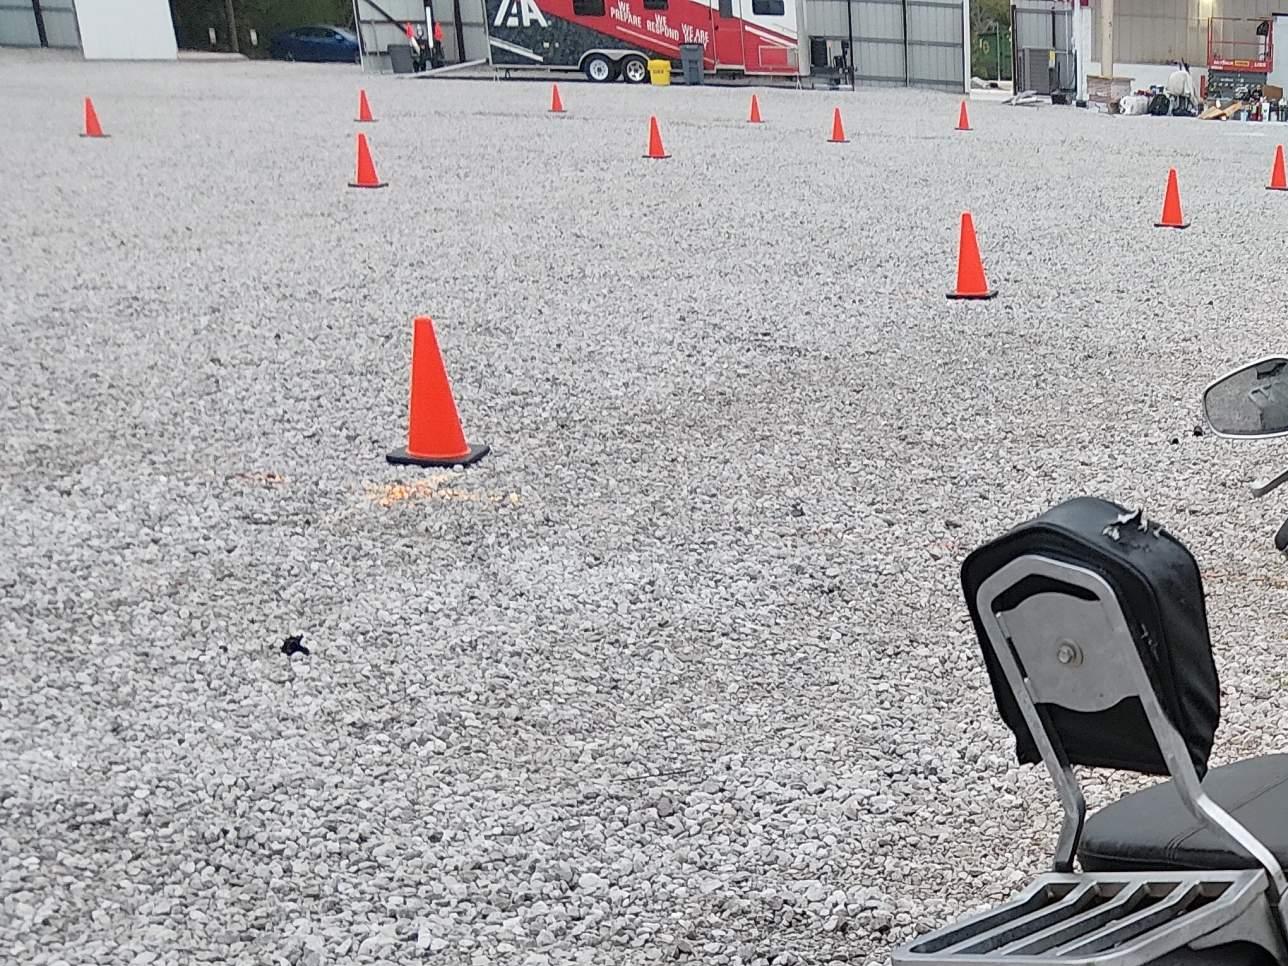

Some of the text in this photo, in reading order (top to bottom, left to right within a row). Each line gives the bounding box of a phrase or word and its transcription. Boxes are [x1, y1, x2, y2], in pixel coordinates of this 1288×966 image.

[610, 6, 642, 29] PREPARE
[617, 0, 630, 14] WE
[646, 19, 680, 41] RESPOND
[654, 13, 667, 27] WE
[681, 22, 709, 43] WE ARE
